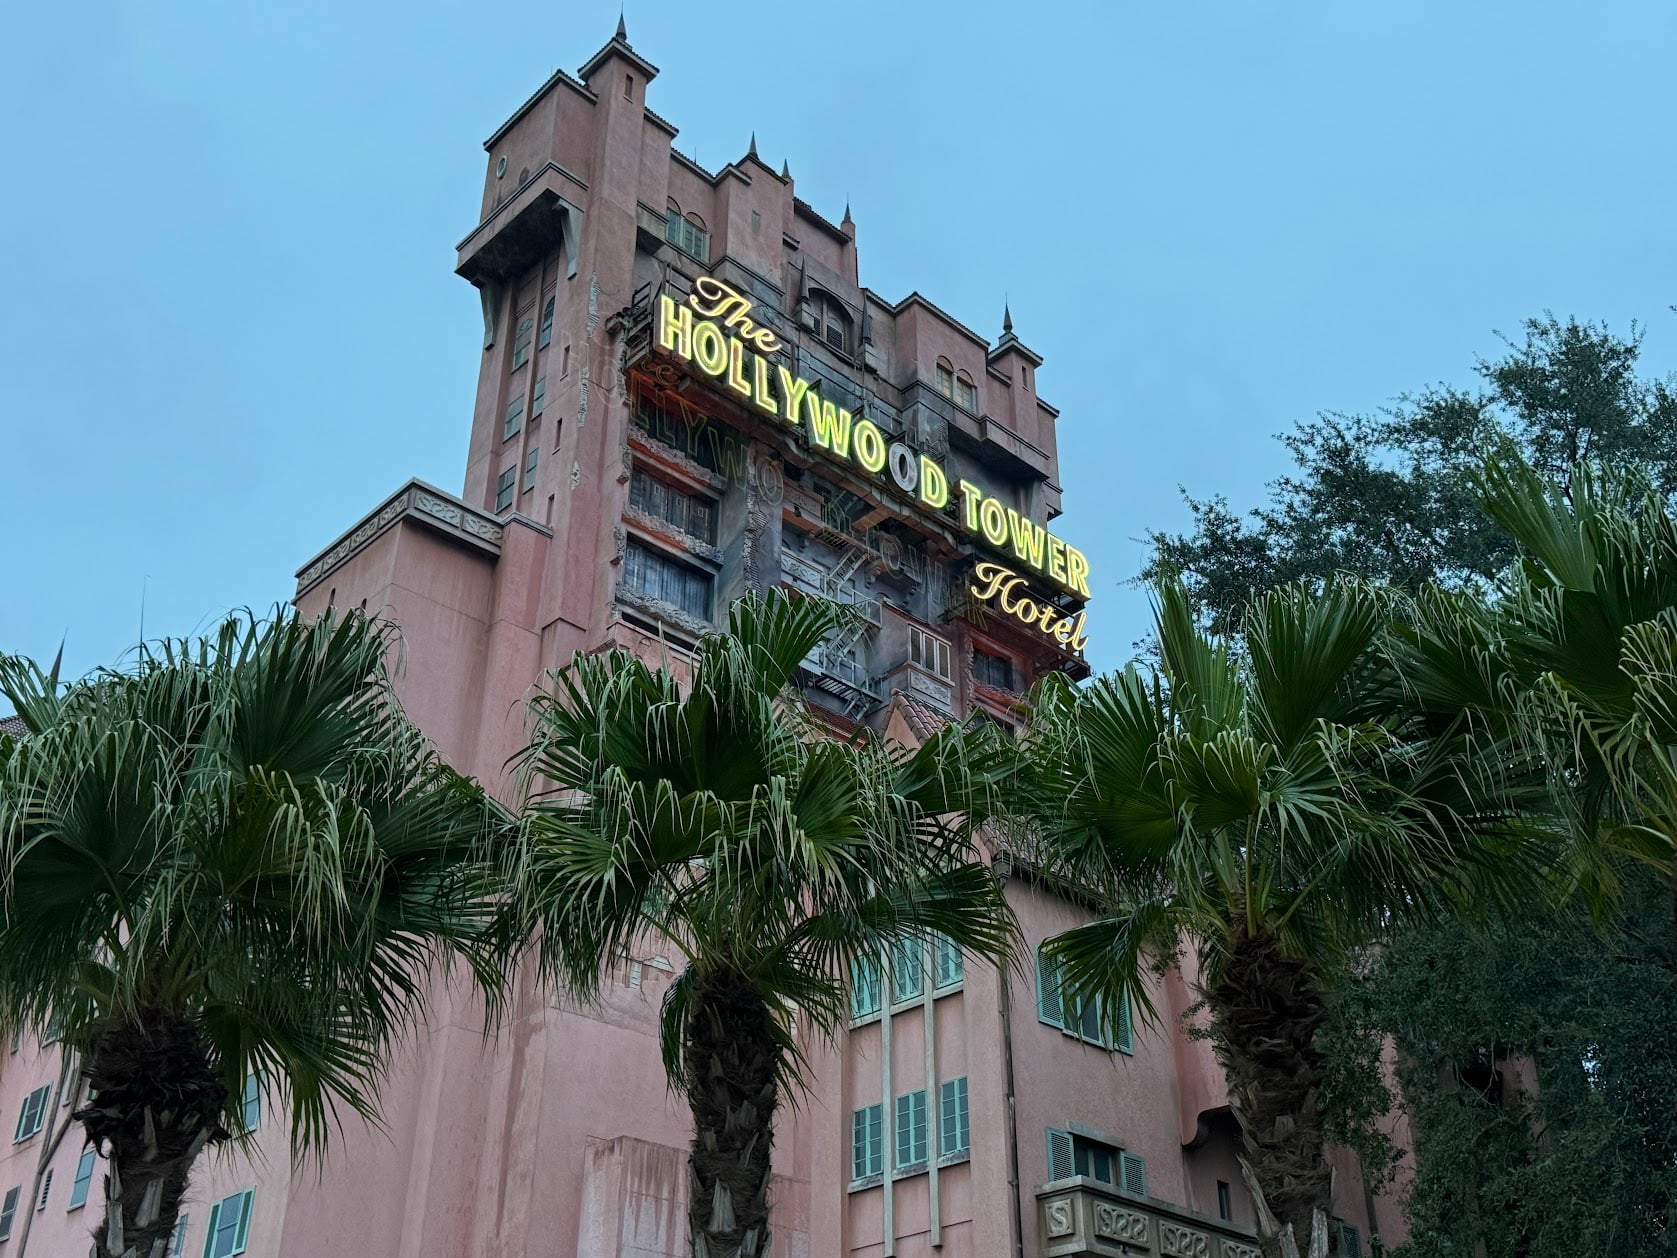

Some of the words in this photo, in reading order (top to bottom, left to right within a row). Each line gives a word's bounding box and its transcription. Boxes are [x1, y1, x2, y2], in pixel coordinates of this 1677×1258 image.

[689, 276, 782, 352] The
[660, 294, 948, 508] HOLLYWOOD
[960, 479, 1091, 599] TOWER
[971, 562, 1089, 650] Hotel
